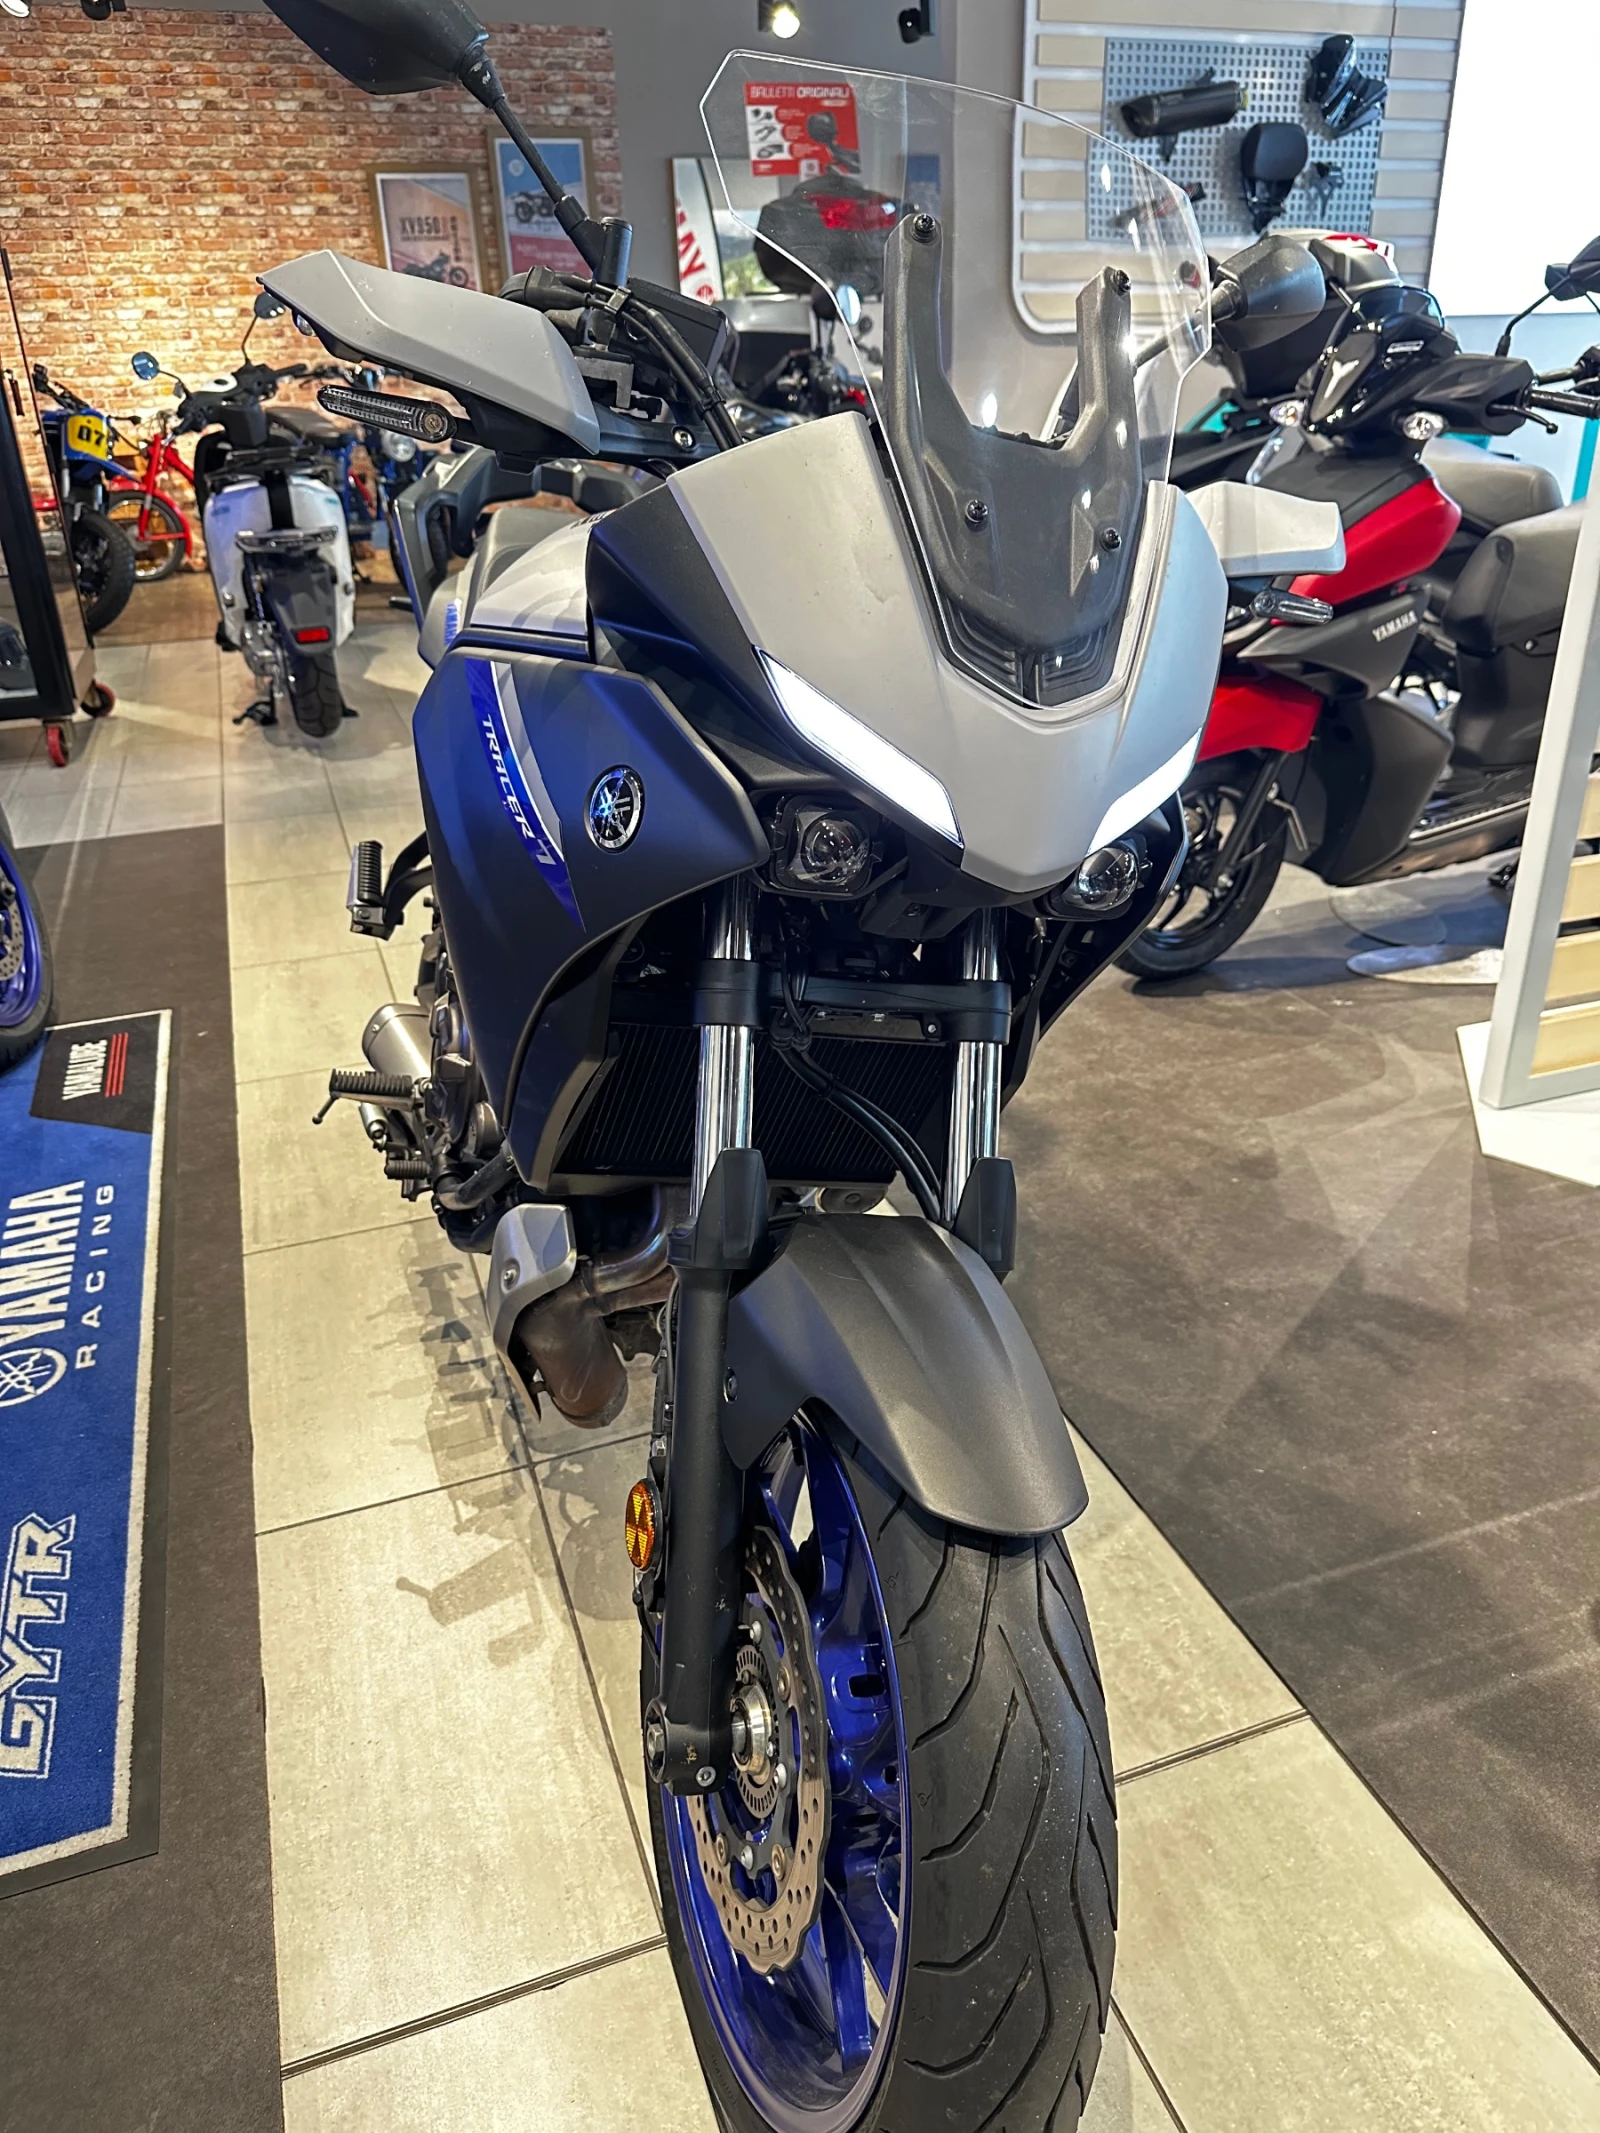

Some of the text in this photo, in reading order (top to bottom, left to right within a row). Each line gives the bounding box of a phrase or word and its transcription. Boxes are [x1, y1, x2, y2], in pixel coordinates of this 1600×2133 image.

[751, 85, 850, 99] BAULETTI ORIGINALI
[1372, 610, 1418, 642] YAMAHA
[482, 713, 557, 866] TRACER 7
[62, 1038, 109, 1101] YAMALUBE
[0, 1180, 86, 1348] YAMAHA
[75, 1184, 116, 1370] RACING
[0, 1512, 76, 1780] GYTR
